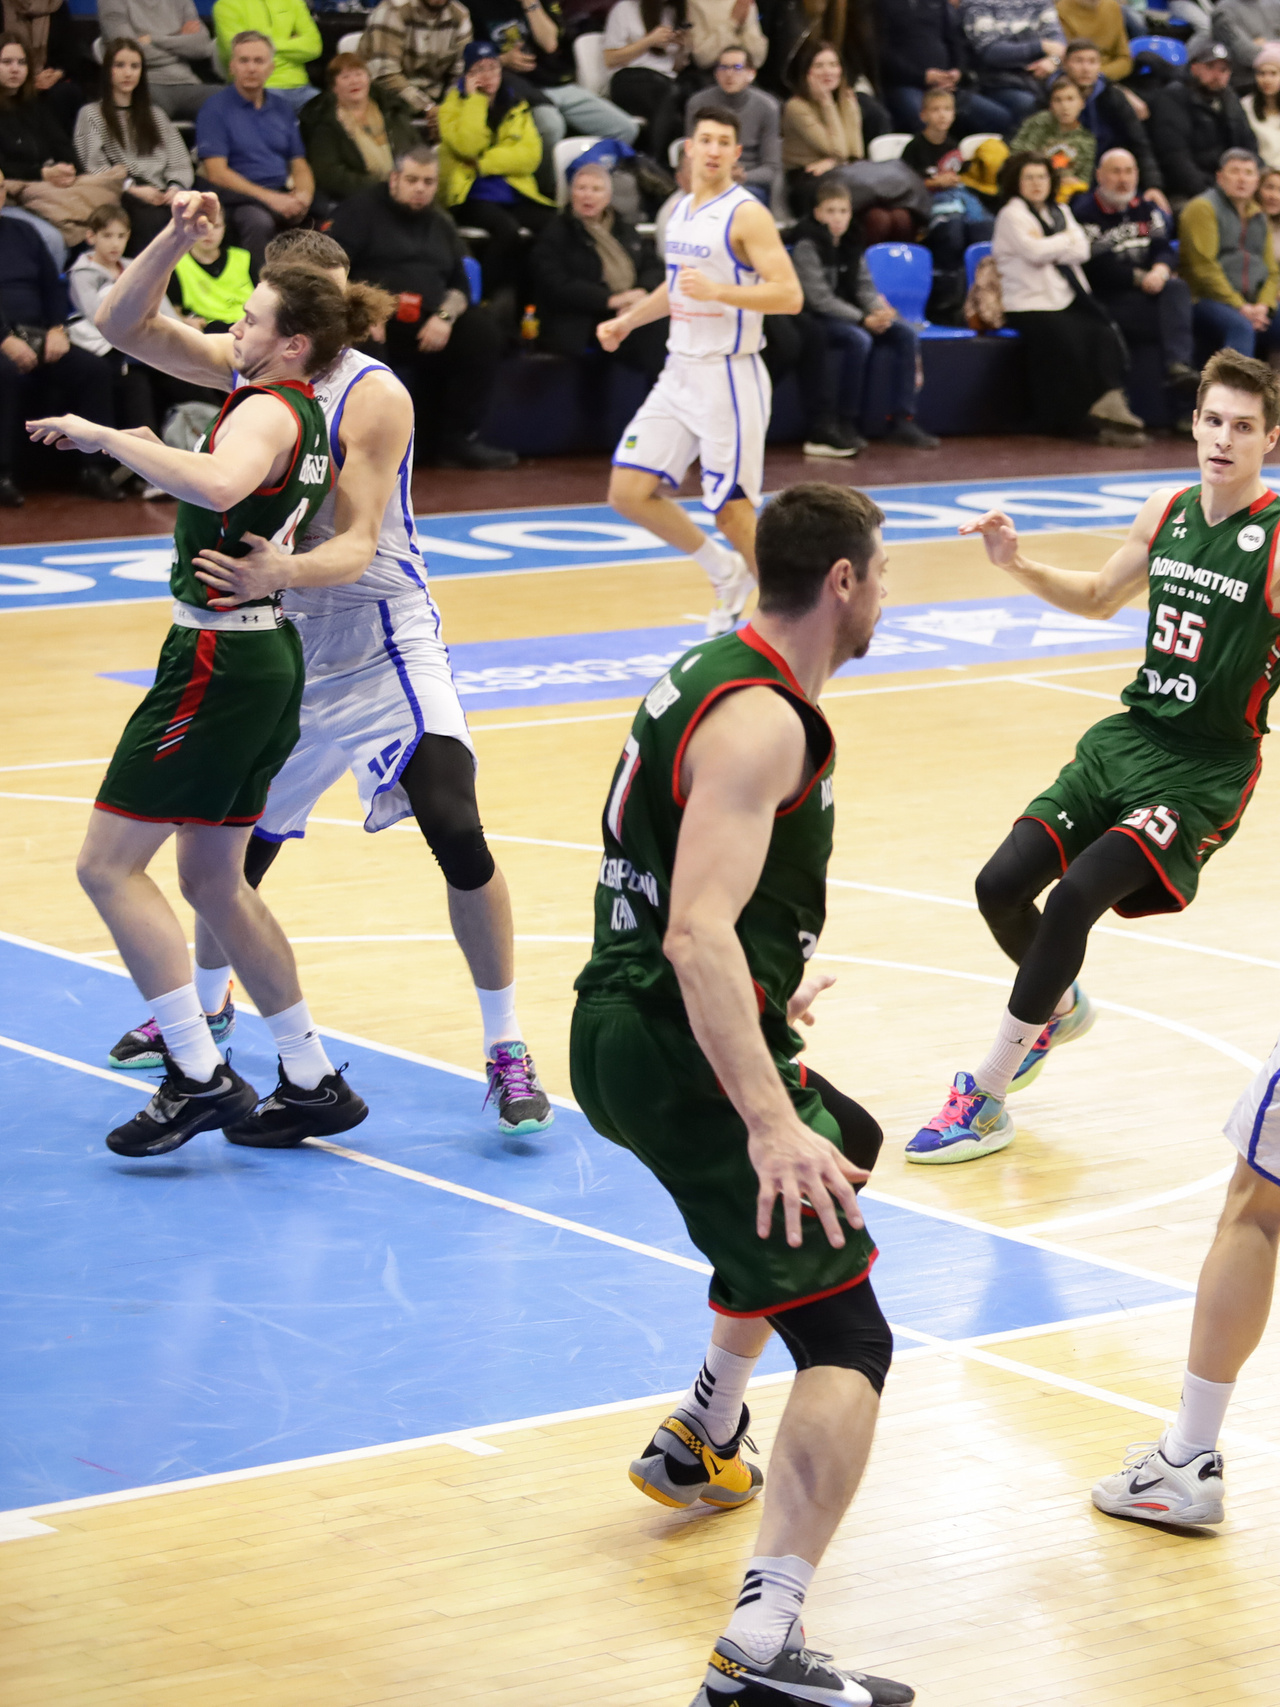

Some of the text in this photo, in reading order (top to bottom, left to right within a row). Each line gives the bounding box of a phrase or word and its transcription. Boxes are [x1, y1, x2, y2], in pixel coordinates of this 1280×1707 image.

[1150, 557, 1249, 603] ЛОКОМОТИВ
[1162, 582, 1211, 605] КУБАНЬ
[1152, 603, 1207, 663] 55
